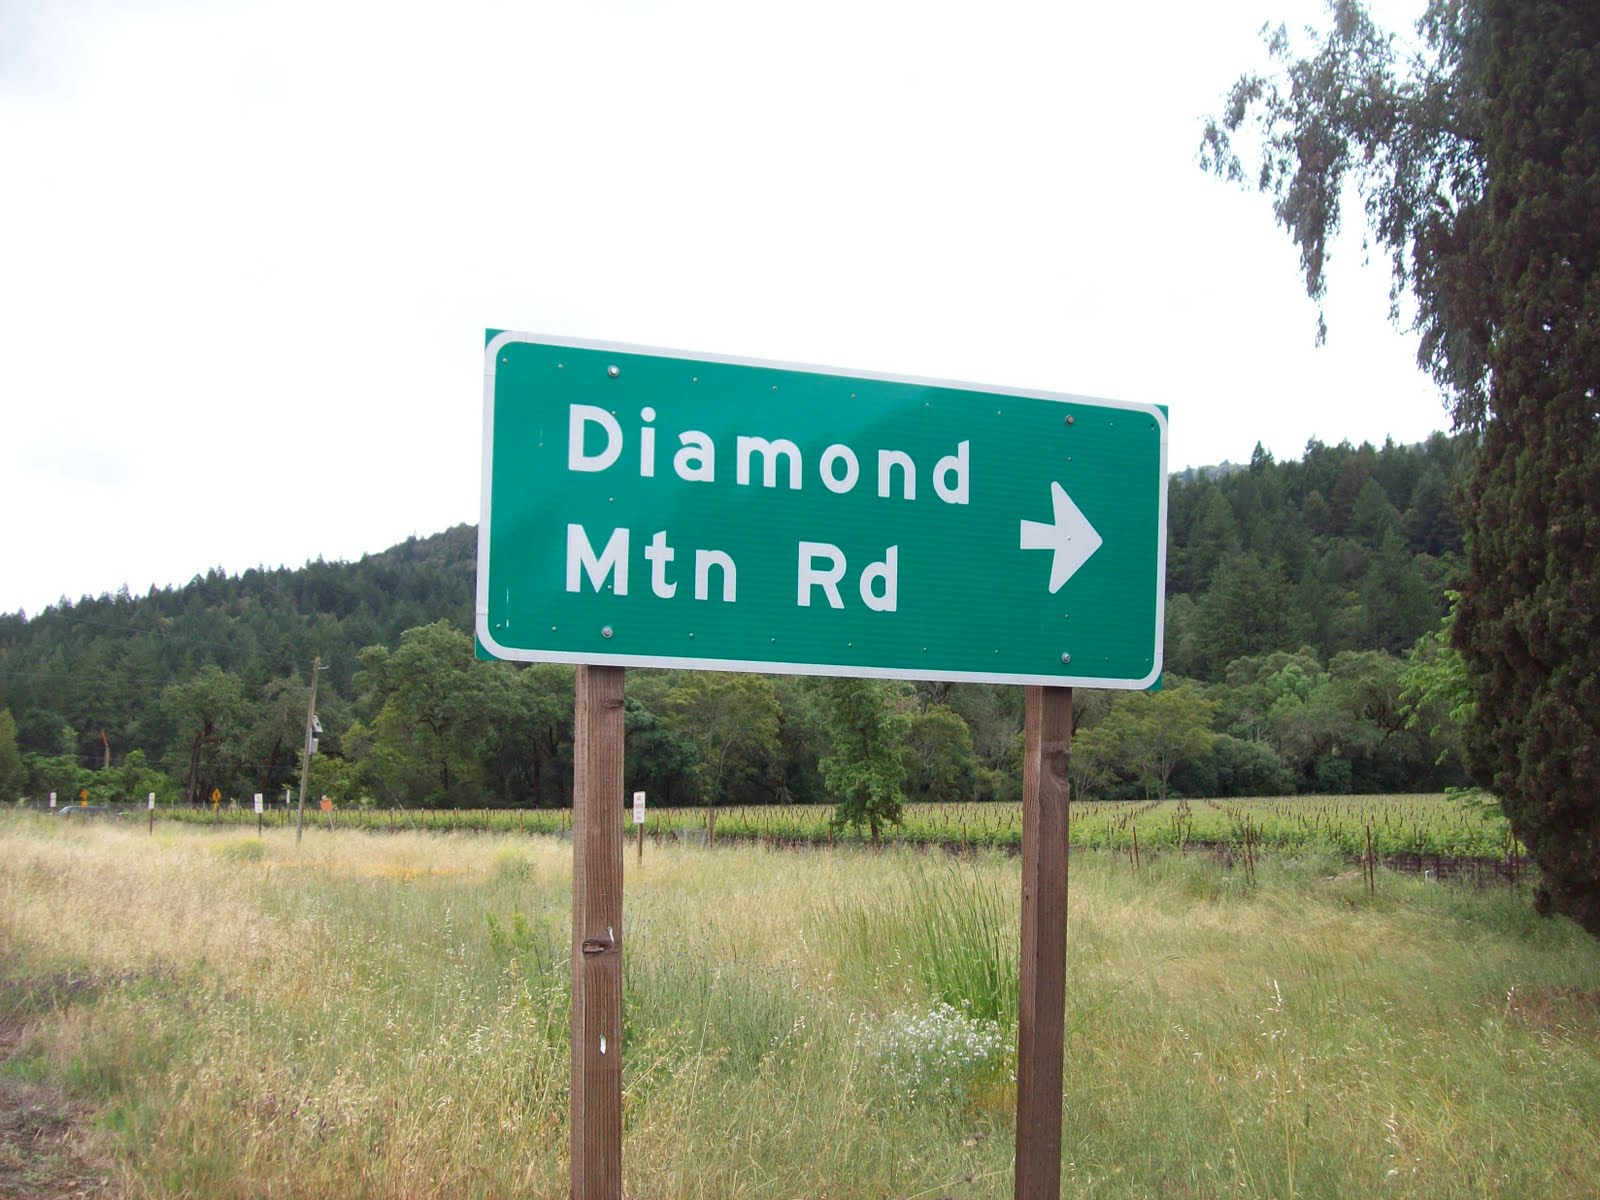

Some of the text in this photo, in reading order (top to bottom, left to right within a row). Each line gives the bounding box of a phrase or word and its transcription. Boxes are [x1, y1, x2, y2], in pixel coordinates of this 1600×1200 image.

[568, 403, 970, 505] Diamond
[566, 523, 898, 612] Mtn Rd
